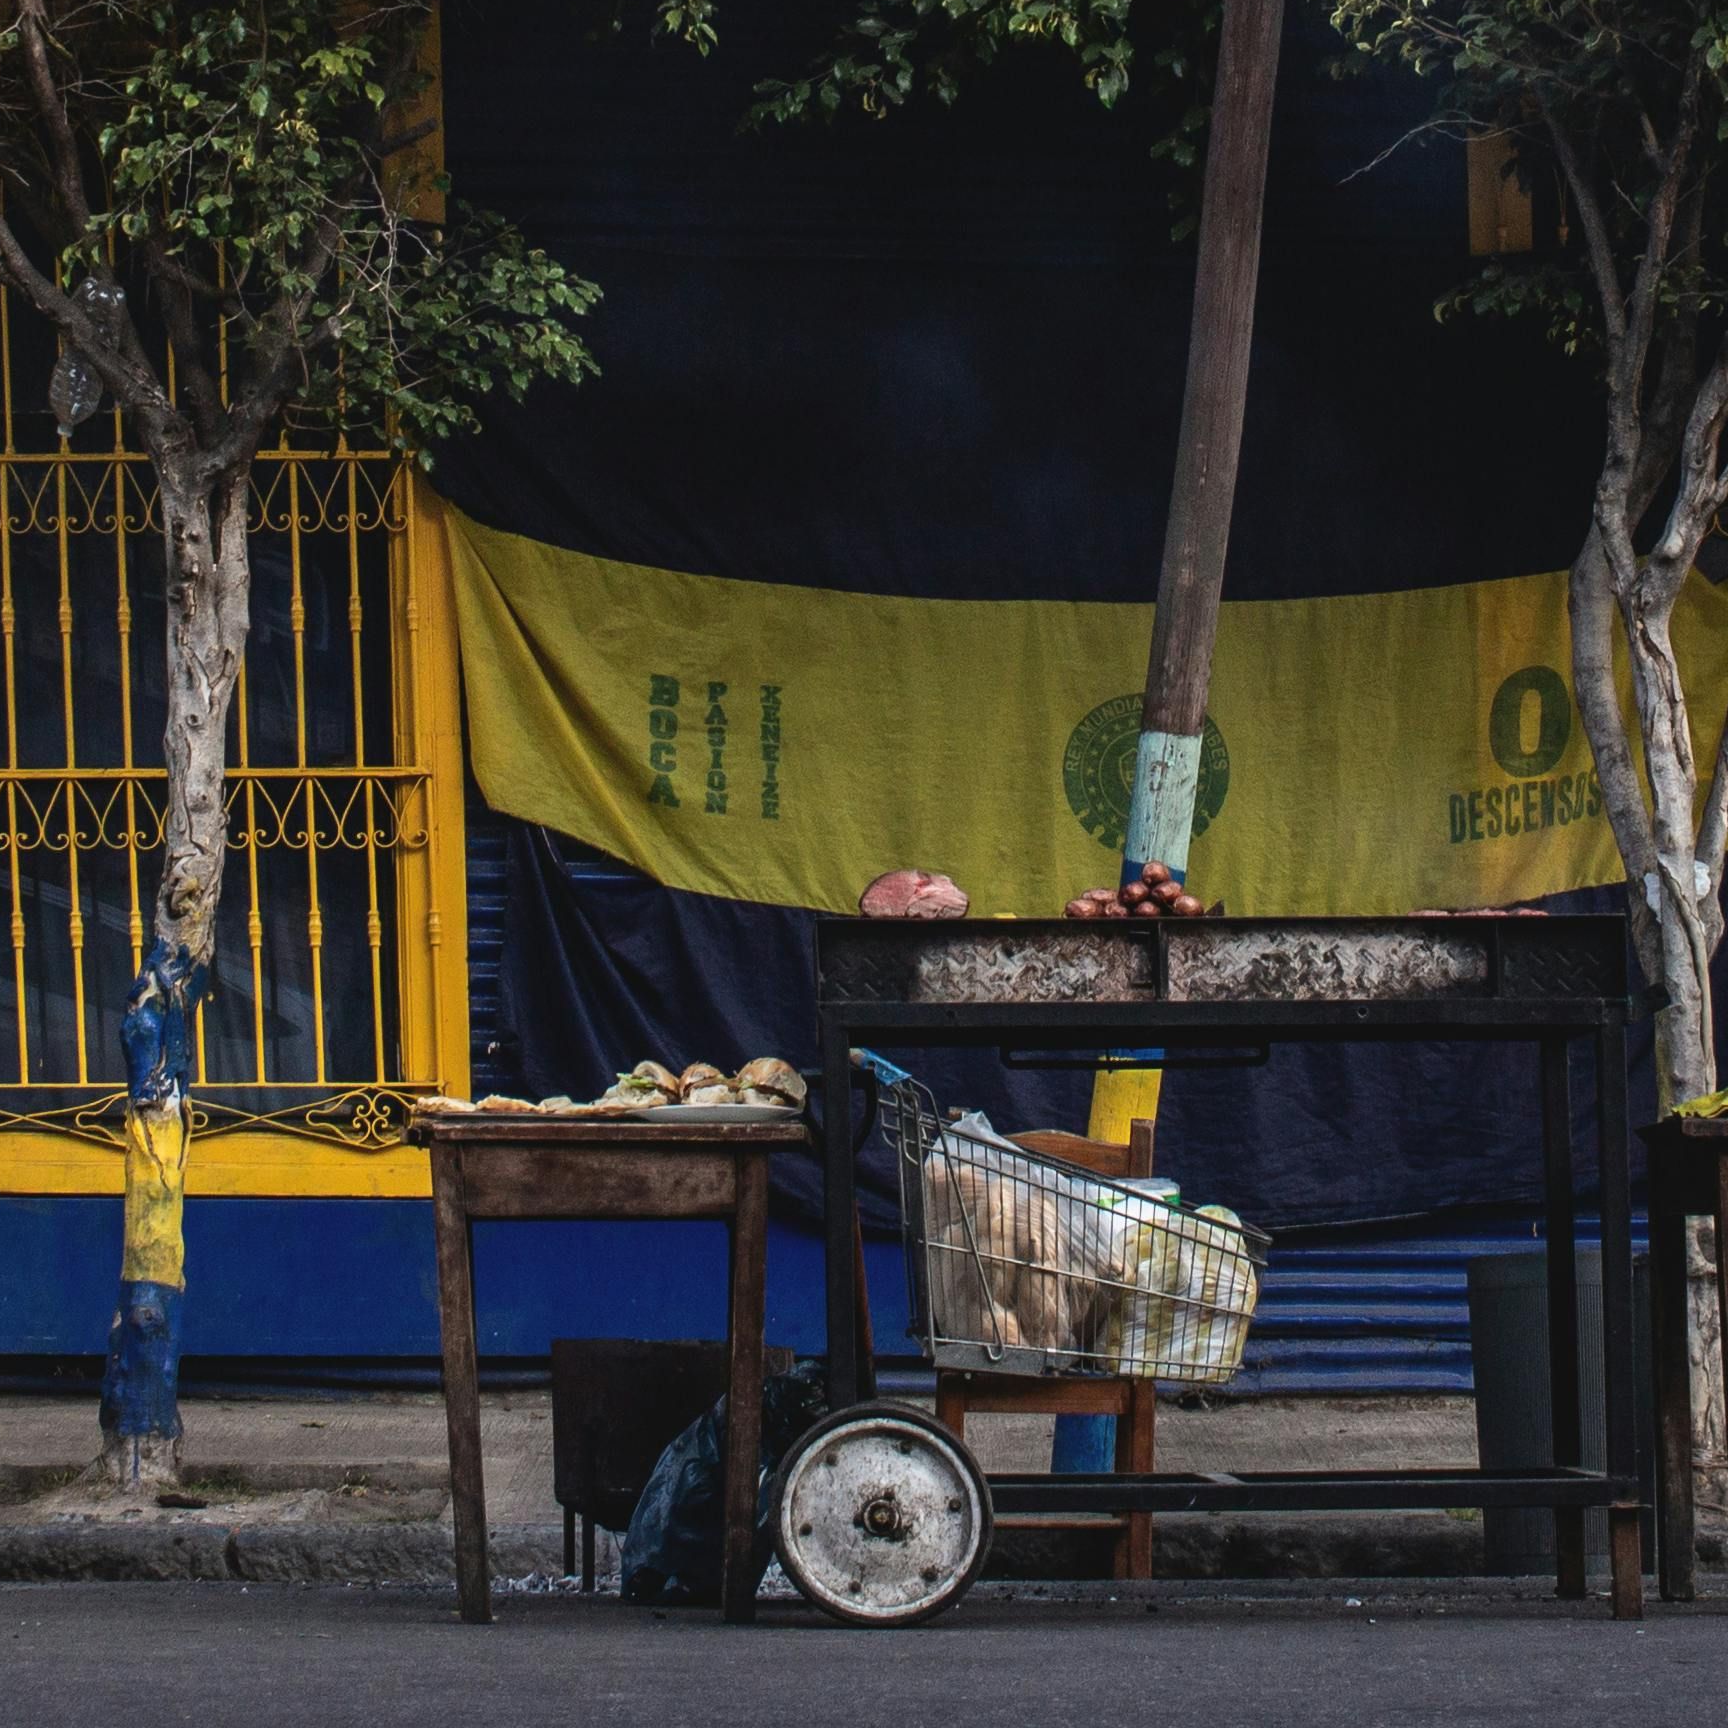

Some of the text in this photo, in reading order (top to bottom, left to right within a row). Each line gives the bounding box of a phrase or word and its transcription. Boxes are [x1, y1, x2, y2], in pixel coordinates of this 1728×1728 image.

[647, 674, 680, 808] BOCA
[704, 681, 728, 814] PASION
[760, 685, 782, 820] XENEIZE
[1065, 736, 1084, 770] REY
[1078, 696, 1144, 737] MUNDIA
[1448, 766, 1603, 844] DESCENSOS
